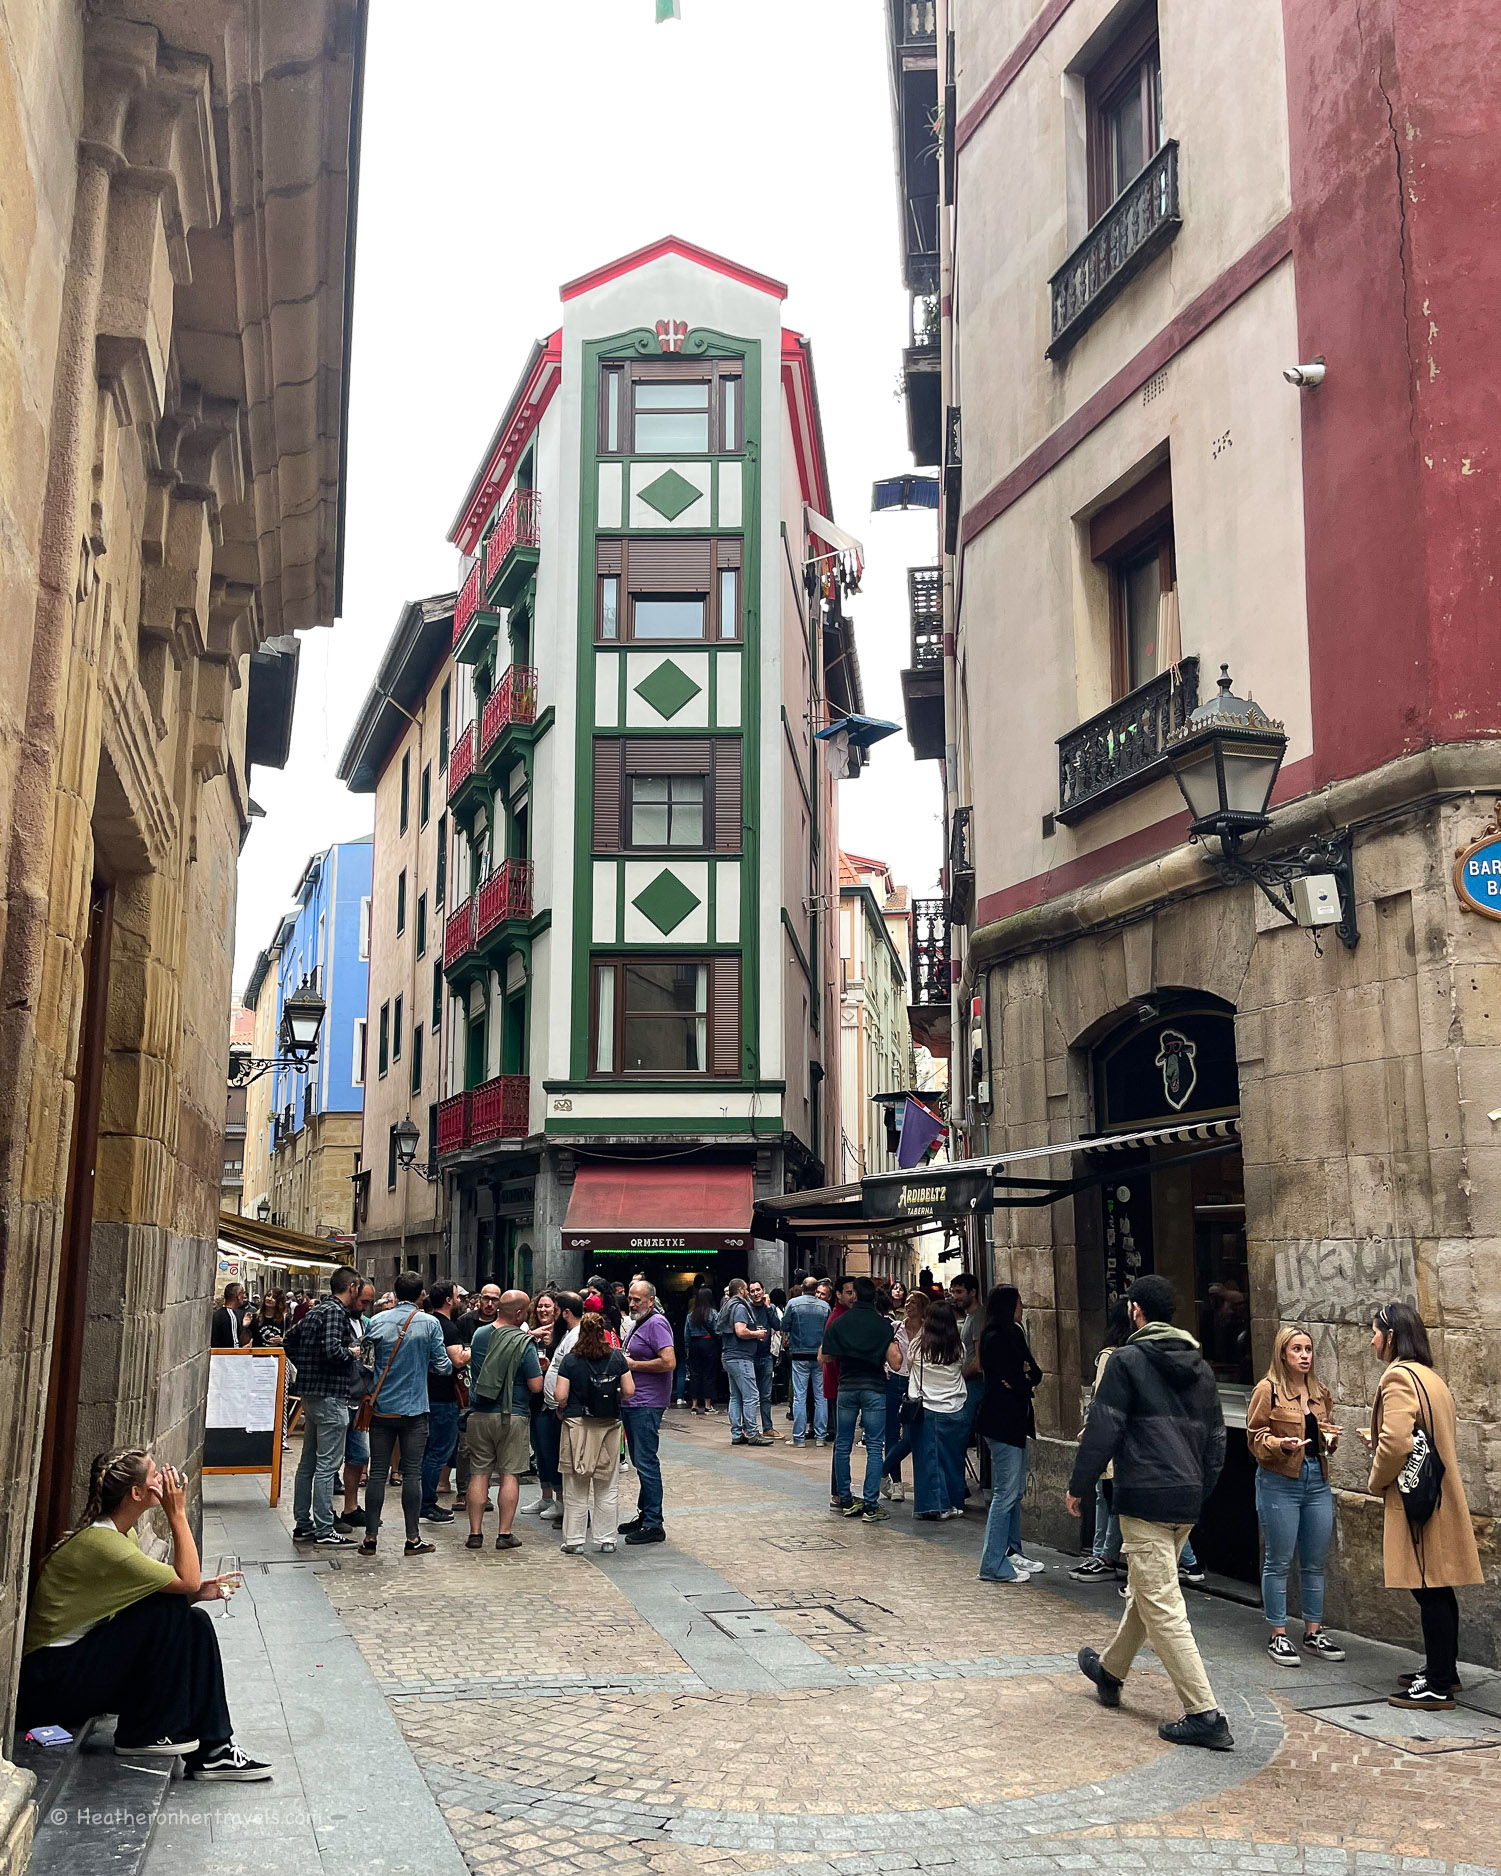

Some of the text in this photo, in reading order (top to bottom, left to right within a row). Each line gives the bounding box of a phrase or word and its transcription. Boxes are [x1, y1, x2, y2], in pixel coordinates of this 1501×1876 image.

[1487, 880, 1501, 896] B
[897, 1185, 947, 1208] ARDIBELTZ
[907, 1206, 933, 1215] TABERNA
[630, 1238, 685, 1247] ORMAETXE
